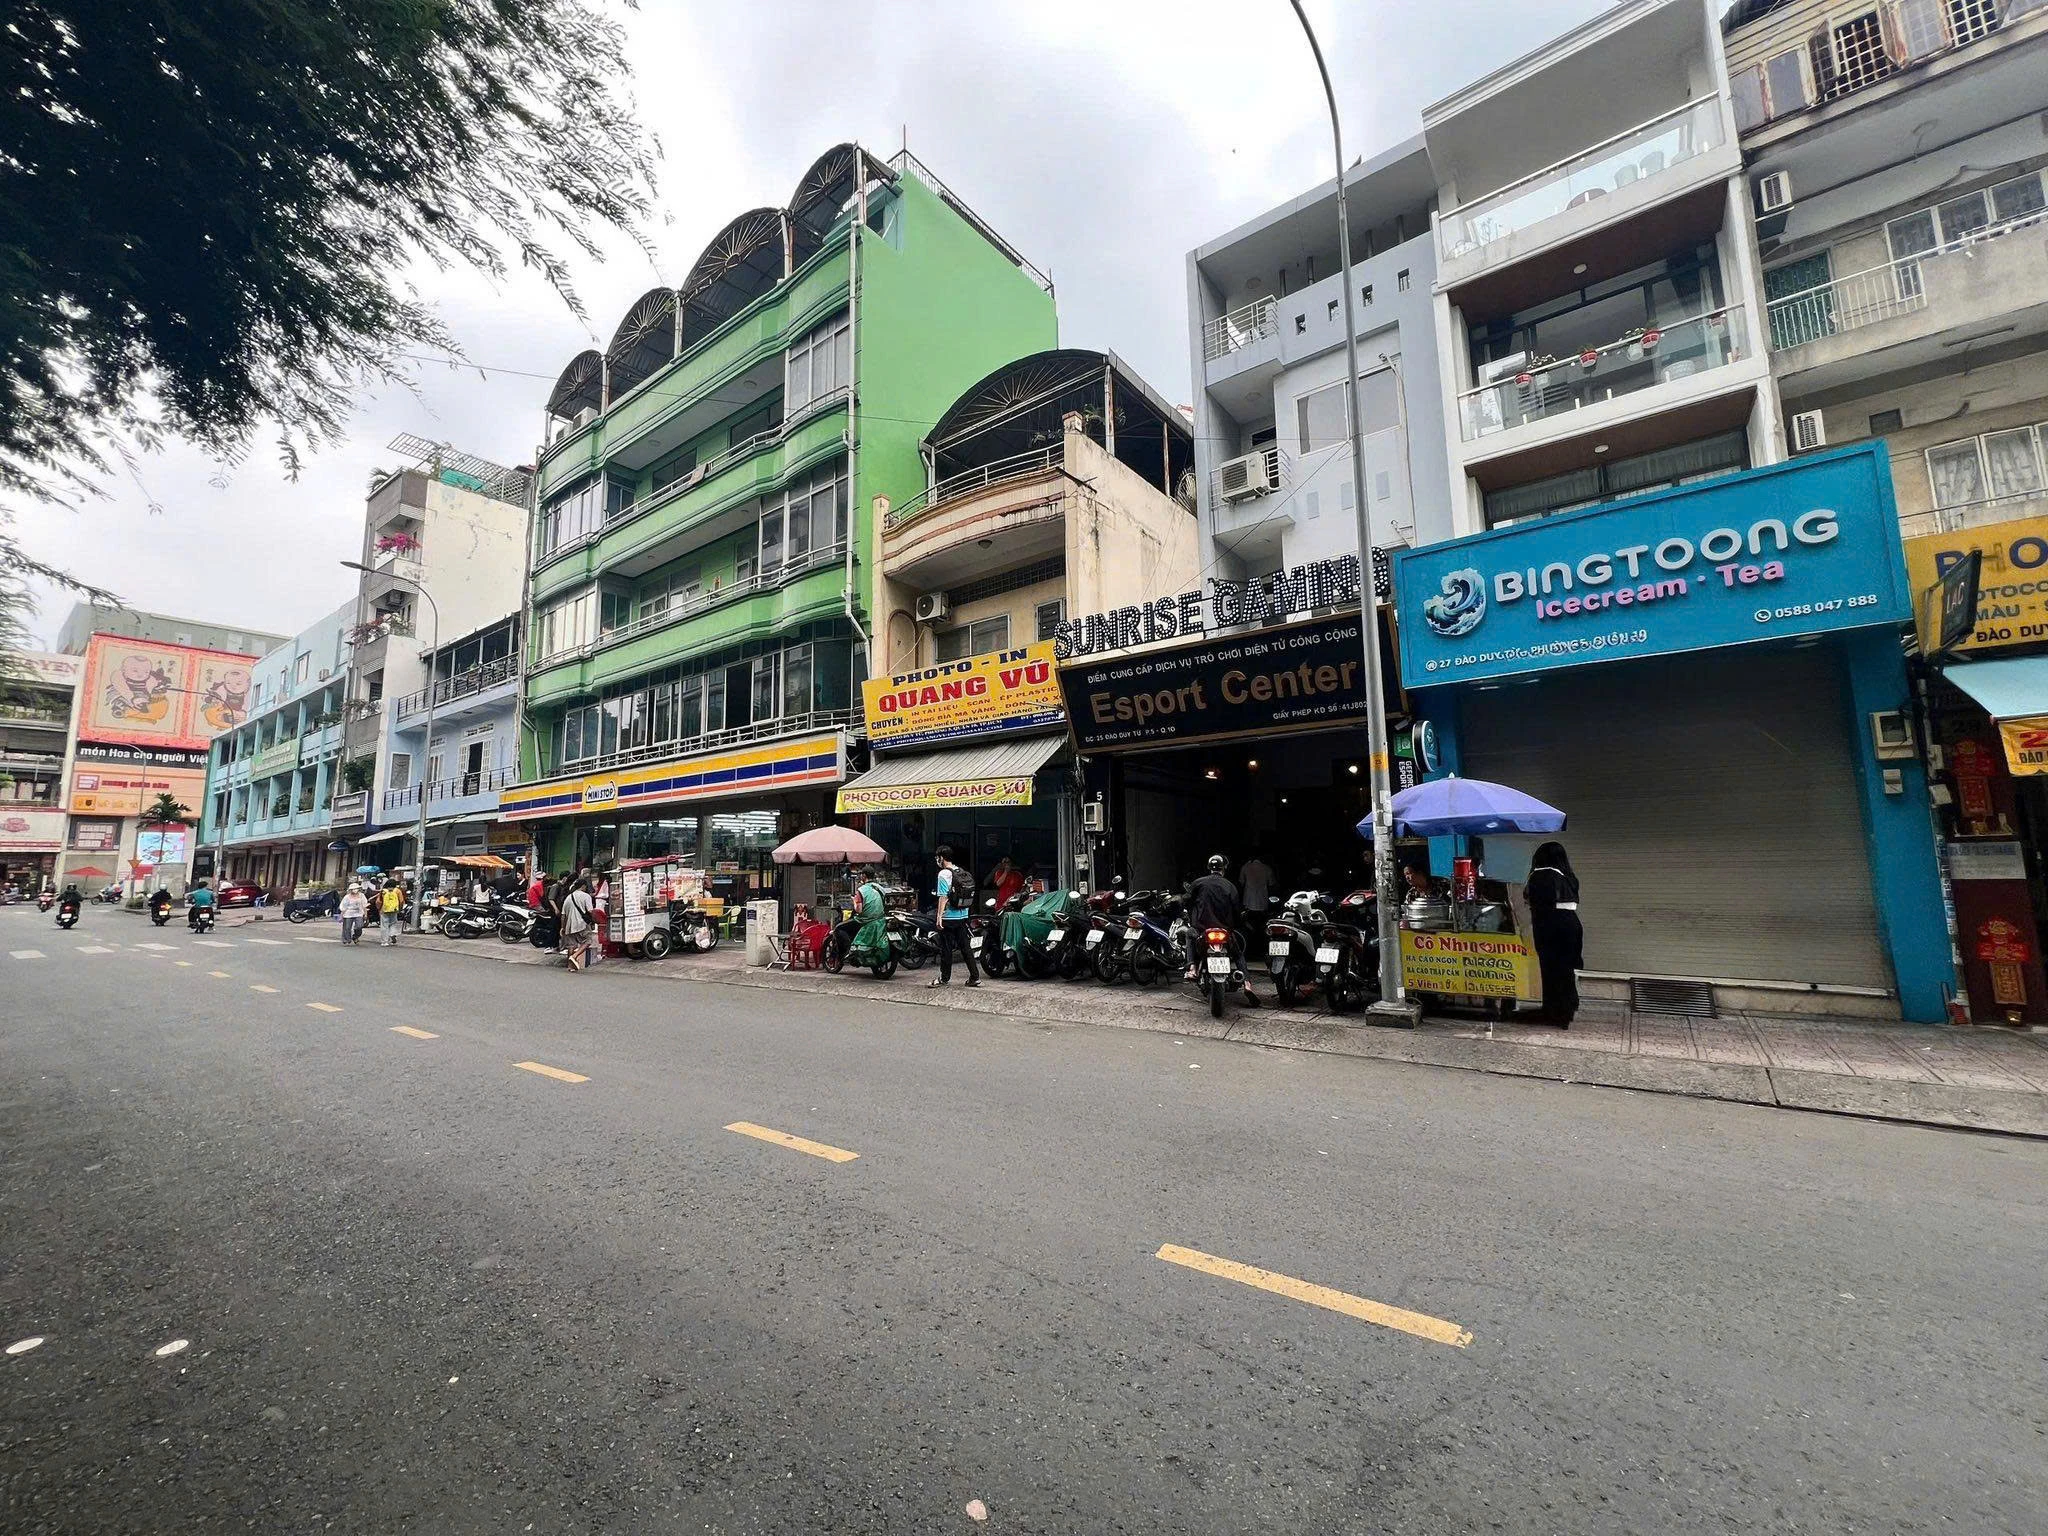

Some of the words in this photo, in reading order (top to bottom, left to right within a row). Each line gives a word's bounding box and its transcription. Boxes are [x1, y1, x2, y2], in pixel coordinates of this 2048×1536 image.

[1494, 508, 1840, 603] BINGTOONG
[1536, 575, 1688, 621] Icecream
[1715, 558, 1786, 588] Tea
[1052, 590, 1202, 661] SUNRISE
[1212, 546, 1391, 628] GAMING
[1774, 604, 1812, 618] 0588
[1814, 600, 1843, 612] 047
[1847, 594, 1878, 607] 888
[1977, 626, 2012, 642] ĐÀO
[1136, 663, 1152, 676] CẤP
[1156, 662, 1177, 672] DỊCH
[1178, 658, 1192, 668] VỤ
[1194, 652, 1214, 664] TRÒ
[1218, 648, 1242, 660] CHƠI
[1244, 644, 1268, 656] ĐIỆN
[1290, 634, 1320, 648] CÔNG
[1324, 628, 1358, 642] CỘNG
[1440, 658, 1452, 669] 27
[1454, 653, 1476, 666] ĐÀO
[892, 660, 973, 686] PHOTO
[1000, 648, 1028, 664] IN
[878, 676, 987, 713] QUANG
[999, 658, 1050, 690] VŨ
[967, 698, 990, 706] SCAN
[1016, 686, 1058, 698] PLASTIC
[1090, 678, 1208, 726] Esport
[1220, 658, 1358, 705] Center
[80, 747, 106, 756] món
[108, 748, 130, 758] Hoa
[133, 750, 153, 760] cho
[156, 752, 186, 763] người
[844, 788, 931, 804] PHOTOCOPY
[936, 784, 996, 798] QUANG
[1414, 936, 1434, 950] Cô
[1408, 978, 1414, 987] 5
